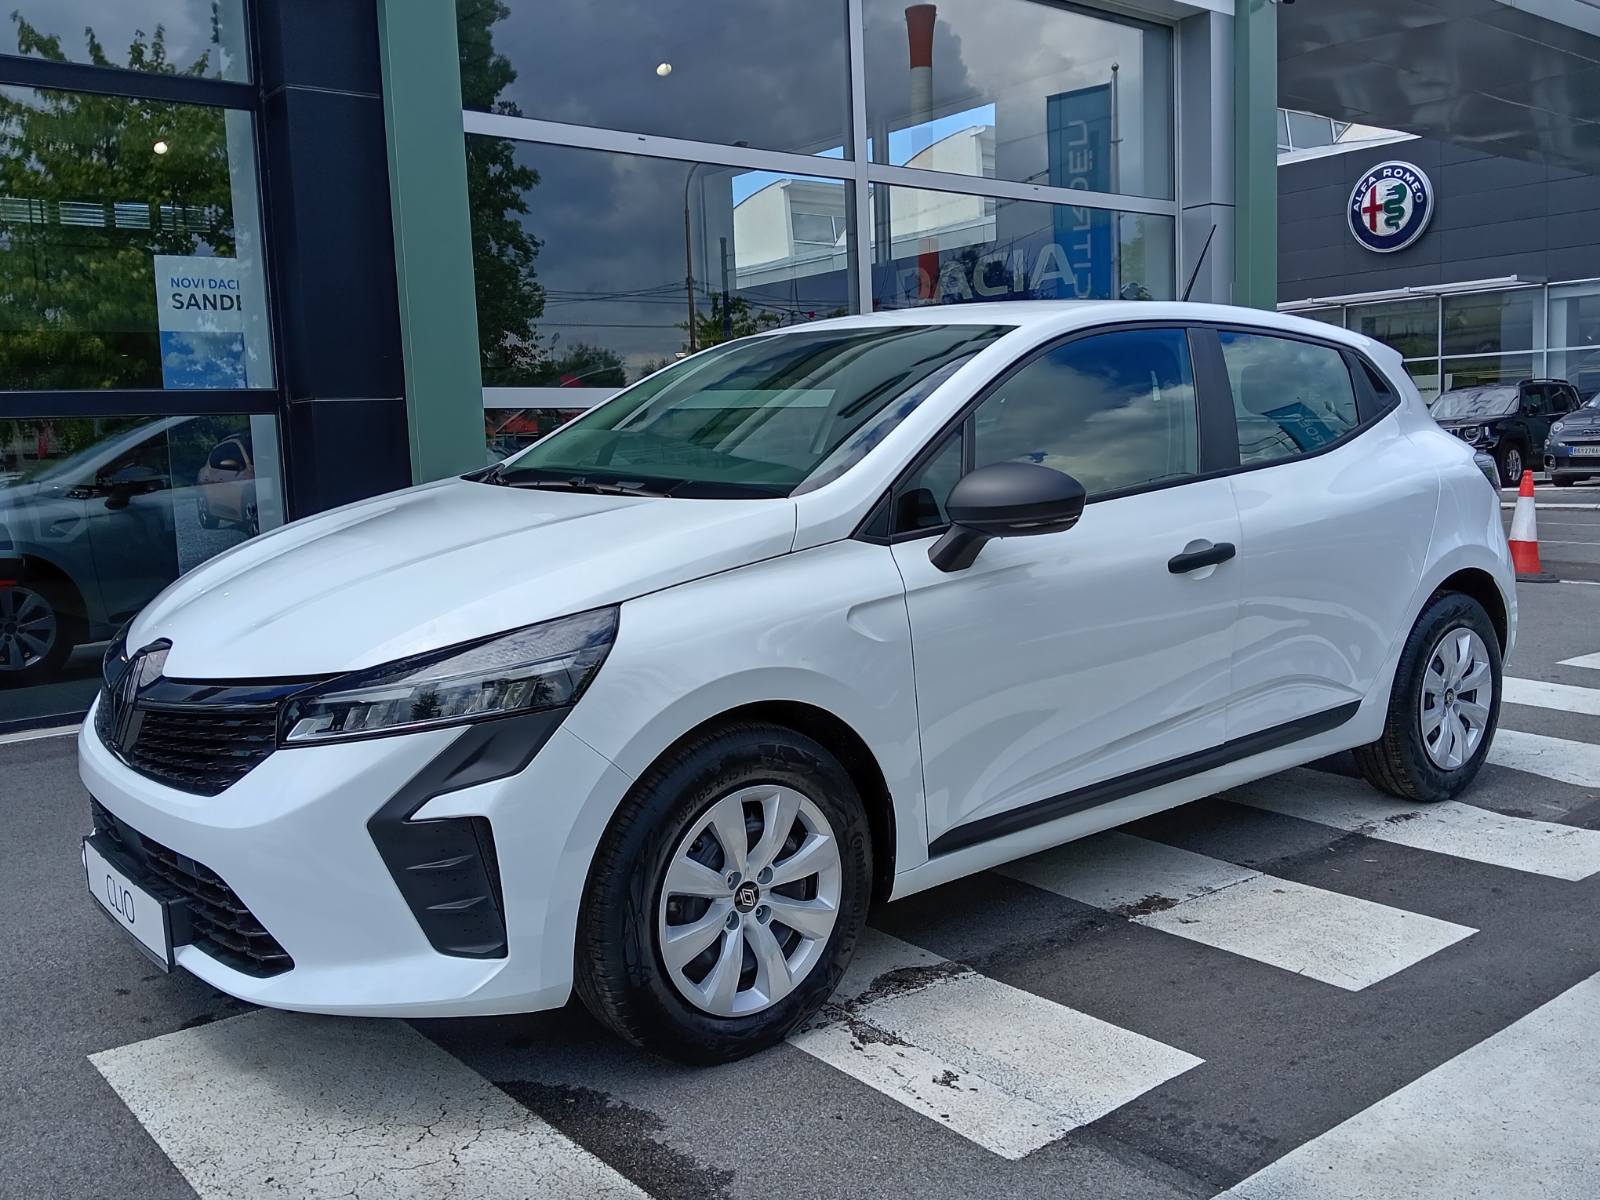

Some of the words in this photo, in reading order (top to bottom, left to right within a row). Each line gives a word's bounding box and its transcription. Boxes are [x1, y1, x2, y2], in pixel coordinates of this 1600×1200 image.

[1353, 176, 1377, 212] ALFA
[1383, 168, 1424, 203] ROMEO
[170, 277, 205, 289] NOVI
[896, 243, 1077, 301] DACIA
[106, 874, 135, 924] CLIO
